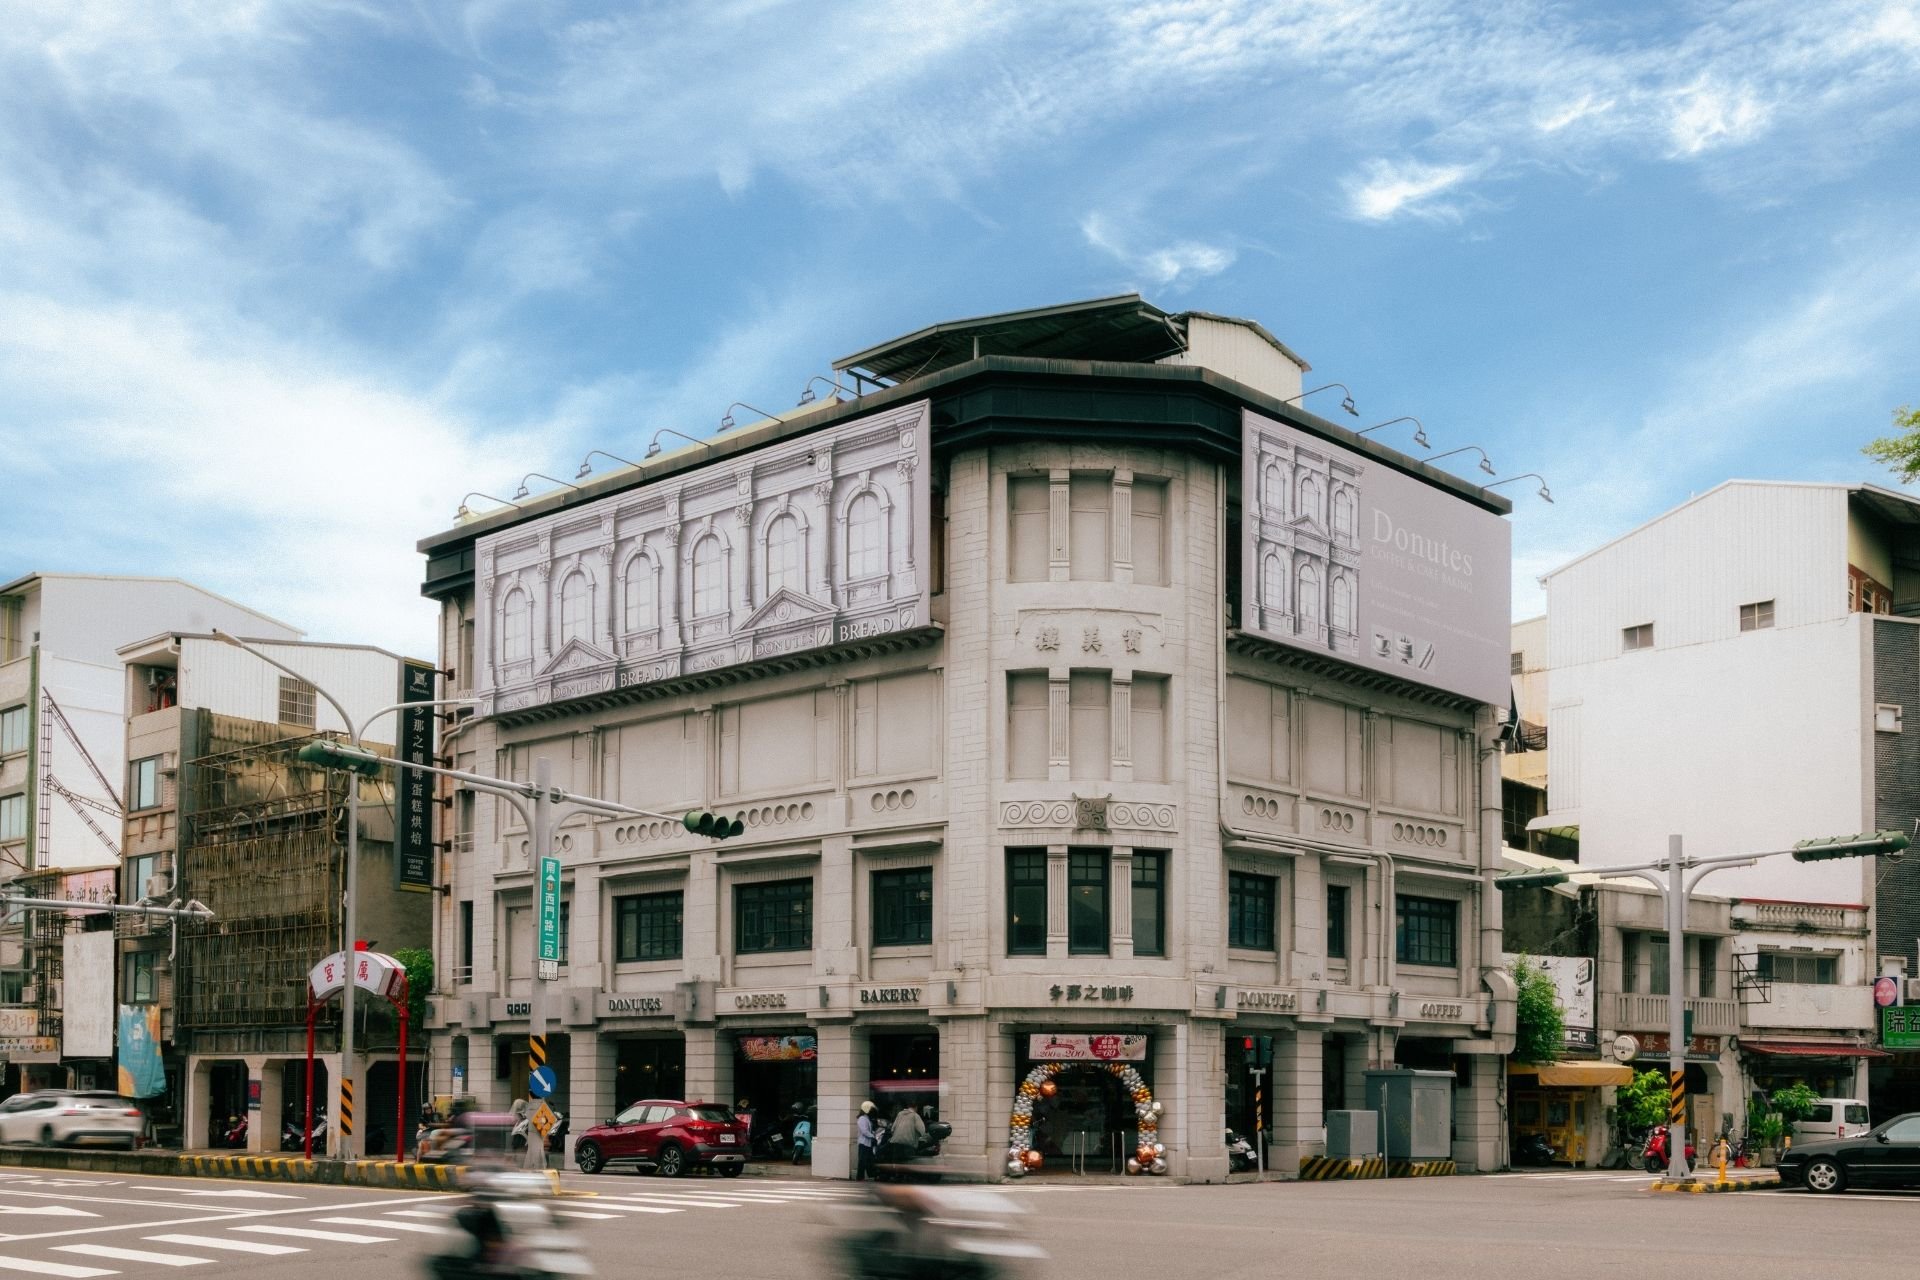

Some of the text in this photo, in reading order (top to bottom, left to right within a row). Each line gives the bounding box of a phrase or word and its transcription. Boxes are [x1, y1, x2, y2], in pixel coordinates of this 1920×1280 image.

[1370, 506, 1473, 577] Donutes
[840, 616, 893, 642] BREAD
[755, 632, 815, 656] DONUTES
[691, 653, 725, 670] CAKE
[620, 665, 665, 688] BREAD
[553, 678, 601, 699] DONUTES
[503, 694, 529, 711] CAKE
[544, 892, 556, 958] 西門路二段
[735, 993, 787, 1009] COFFEE
[860, 988, 921, 1005] BAKERY
[1049, 984, 1134, 1002] 多那之咖啡
[1237, 991, 1297, 1009] DONUTES
[608, 998, 663, 1012] DONUTES
[1420, 1002, 1463, 1018] COFFEE
